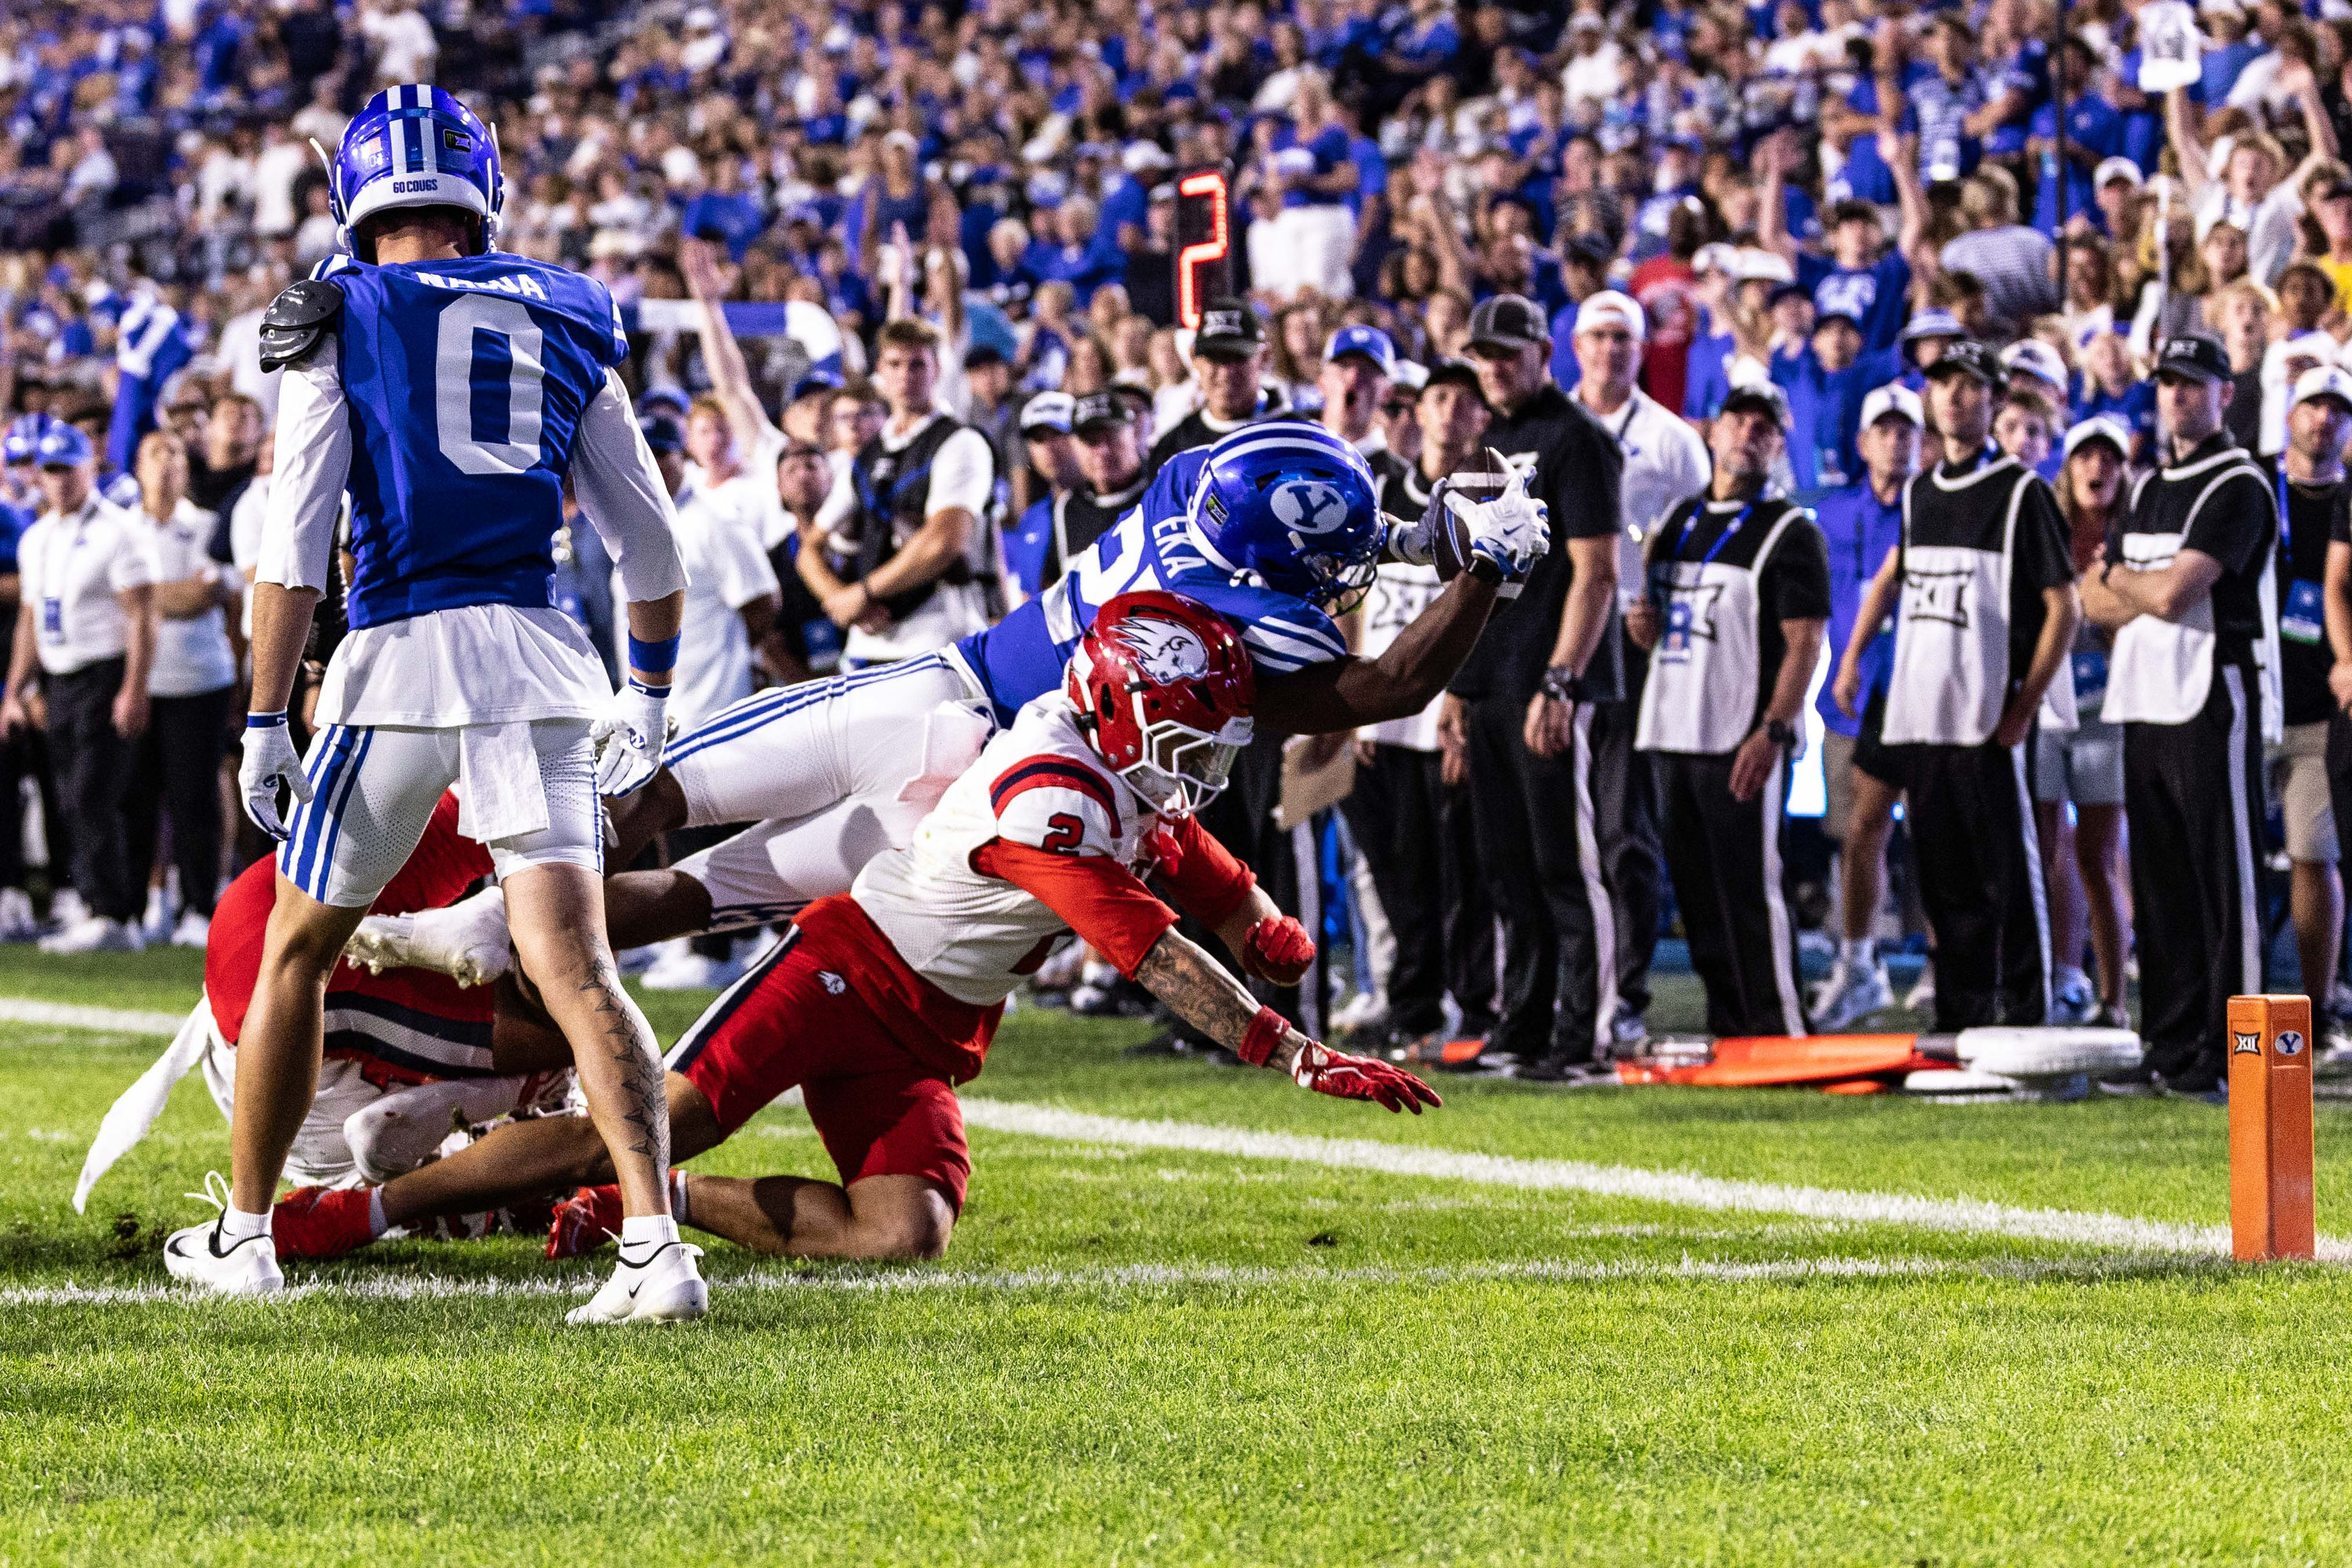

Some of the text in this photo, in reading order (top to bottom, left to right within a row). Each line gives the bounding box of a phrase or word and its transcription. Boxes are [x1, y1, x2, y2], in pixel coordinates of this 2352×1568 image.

[393, 179, 438, 194] GO COUGS
[1179, 173, 1228, 331] 2
[436, 292, 546, 475] 0
[1287, 485, 1338, 528] Y
[1041, 811, 1085, 857] 2
[2279, 1033, 2301, 1054] Y
